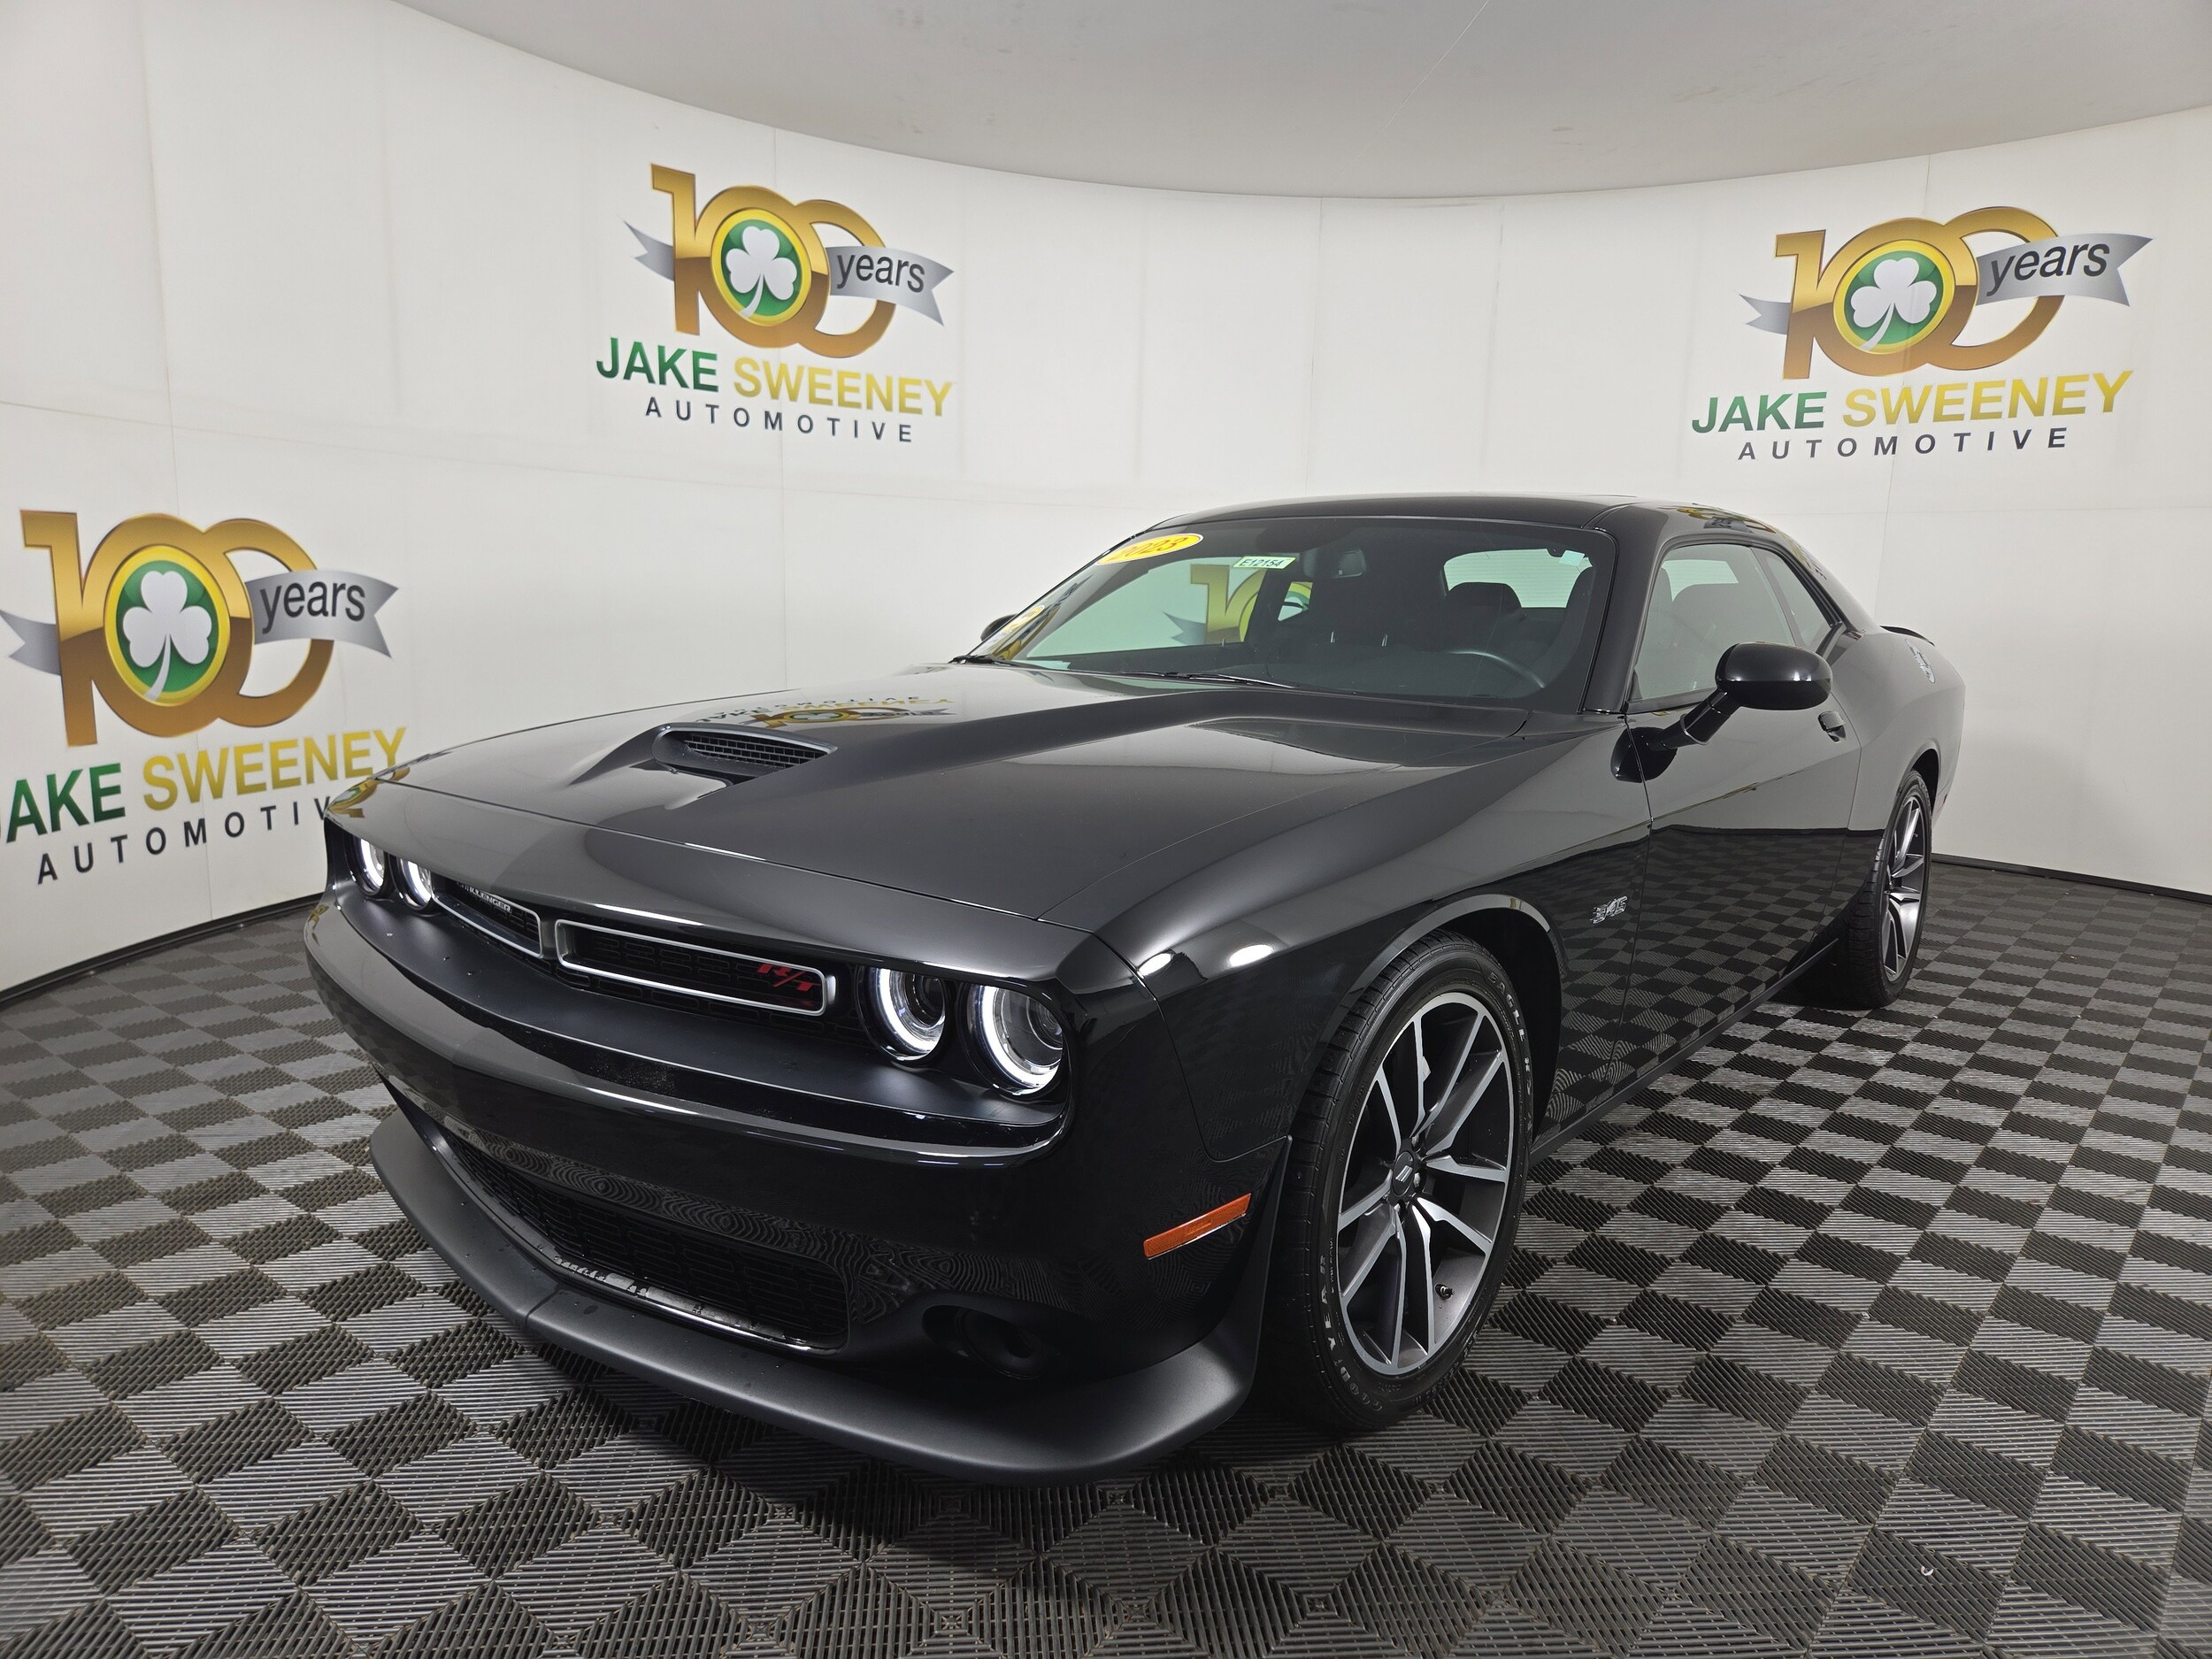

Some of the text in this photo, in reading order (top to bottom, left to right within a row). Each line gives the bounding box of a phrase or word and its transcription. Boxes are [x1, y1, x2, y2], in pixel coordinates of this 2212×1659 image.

[836, 253, 926, 293] years
[1986, 243, 2110, 296] years
[596, 337, 953, 417] JAKE SWEENEY
[1692, 370, 2134, 434] JAKE SWEENEY
[645, 396, 912, 442] AUTOMOTIVE
[1738, 427, 2068, 461] AUTOMOTIVE
[1108, 537, 1189, 561] 2023
[1240, 558, 1285, 568] E12154
[259, 581, 365, 634] years
[0, 727, 406, 843] AKE SWEENEY
[37, 796, 331, 885] AUTOMOTIV
